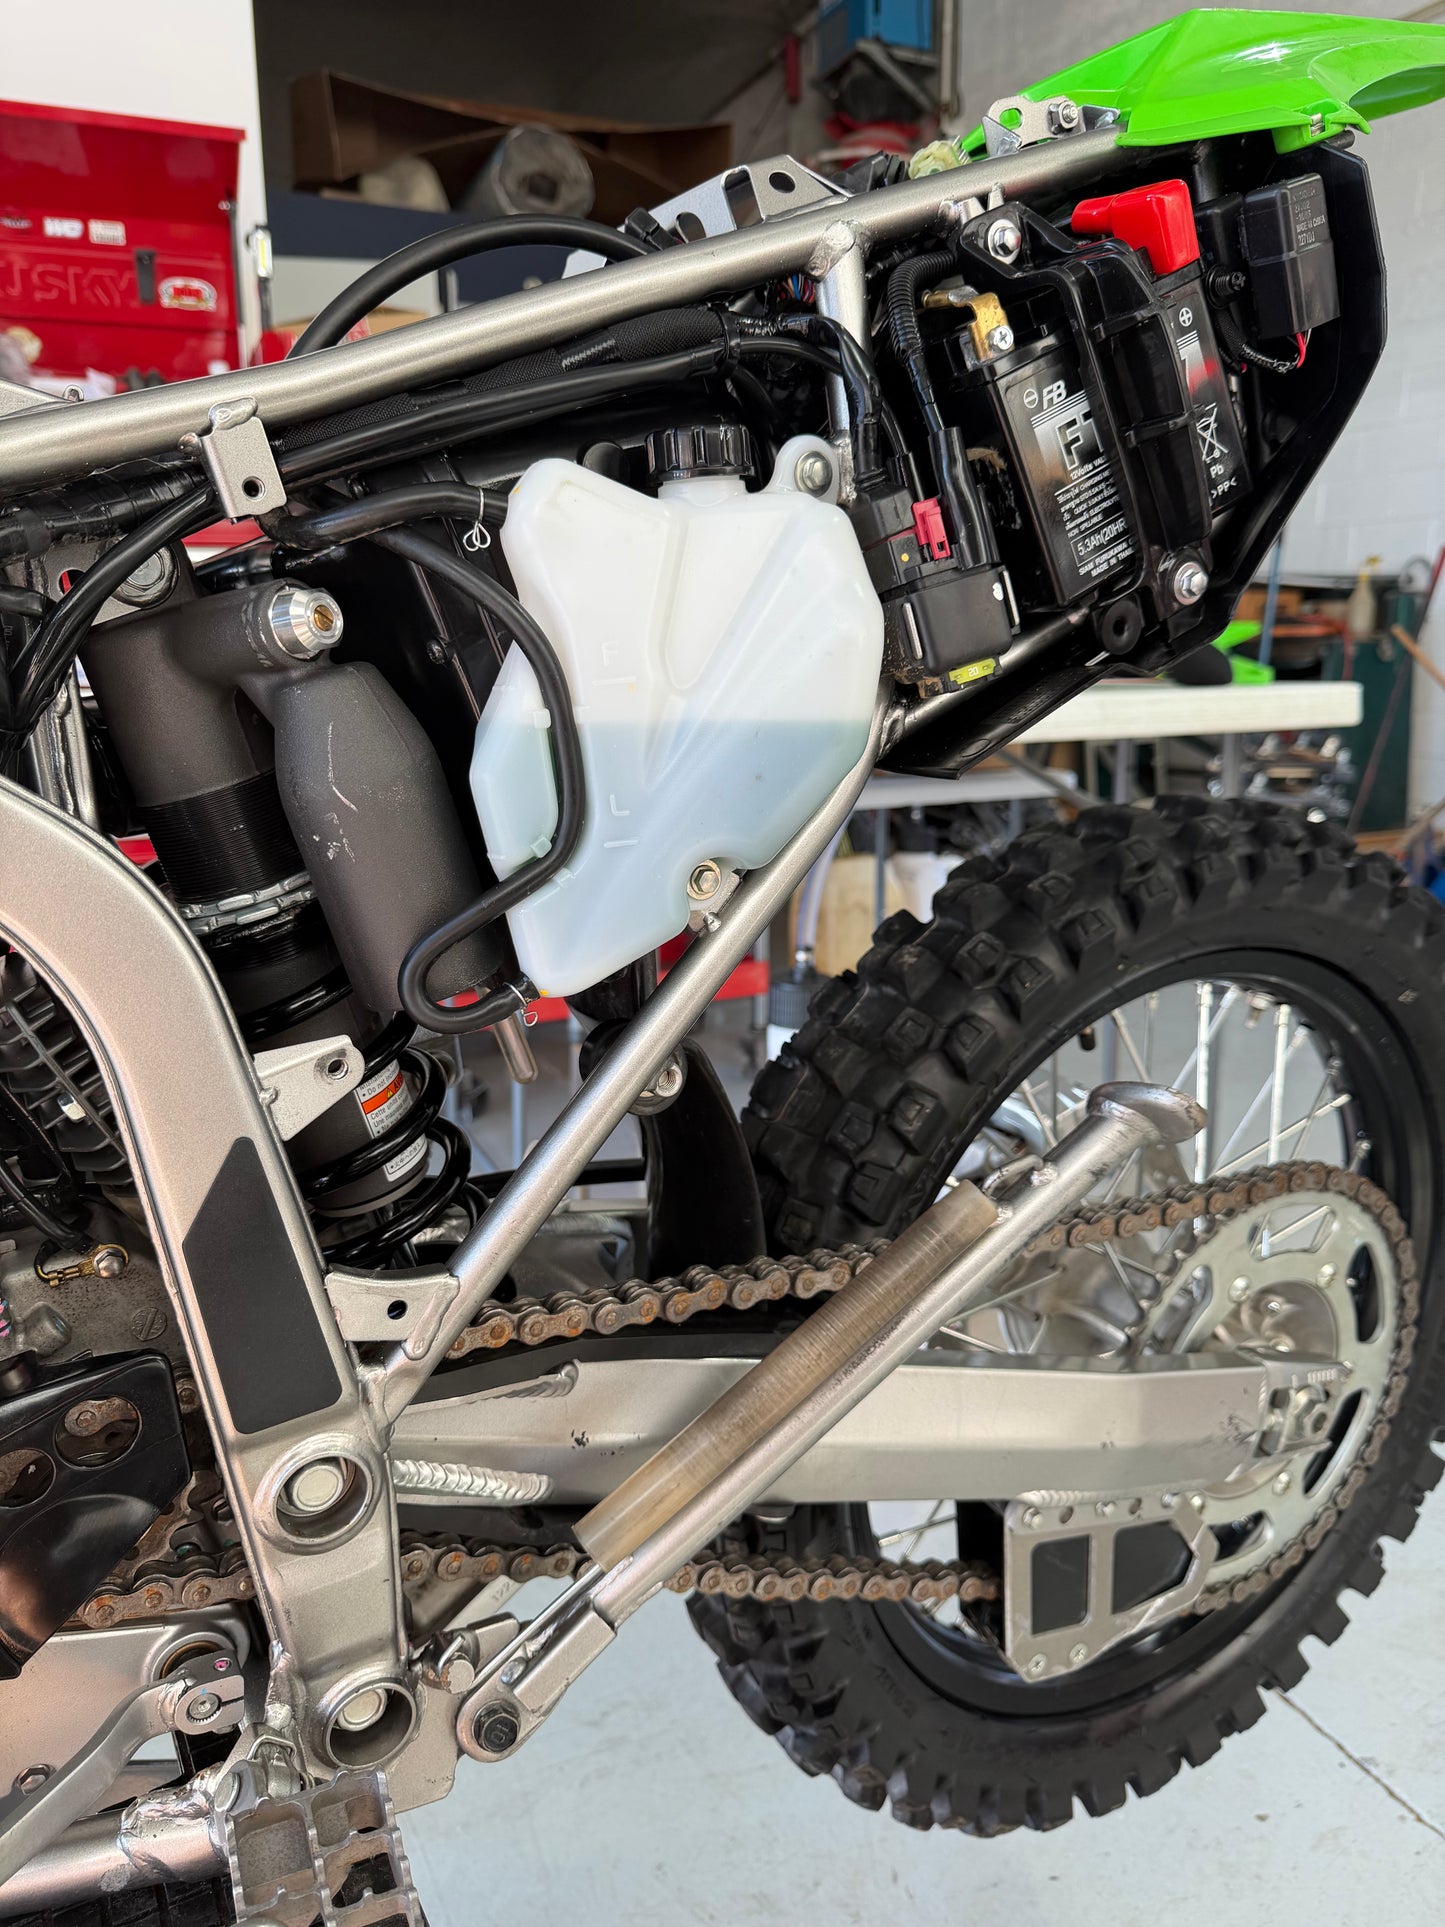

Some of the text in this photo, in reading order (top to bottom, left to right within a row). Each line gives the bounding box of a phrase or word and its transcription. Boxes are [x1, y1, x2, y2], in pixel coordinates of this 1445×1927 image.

[1042, 380, 1067, 410] FB
[1210, 463, 1225, 479] Pb
[1078, 561, 1094, 575] SIAM
[1094, 541, 1127, 565] FURUKAWA
[1090, 561, 1109, 577] MADE
